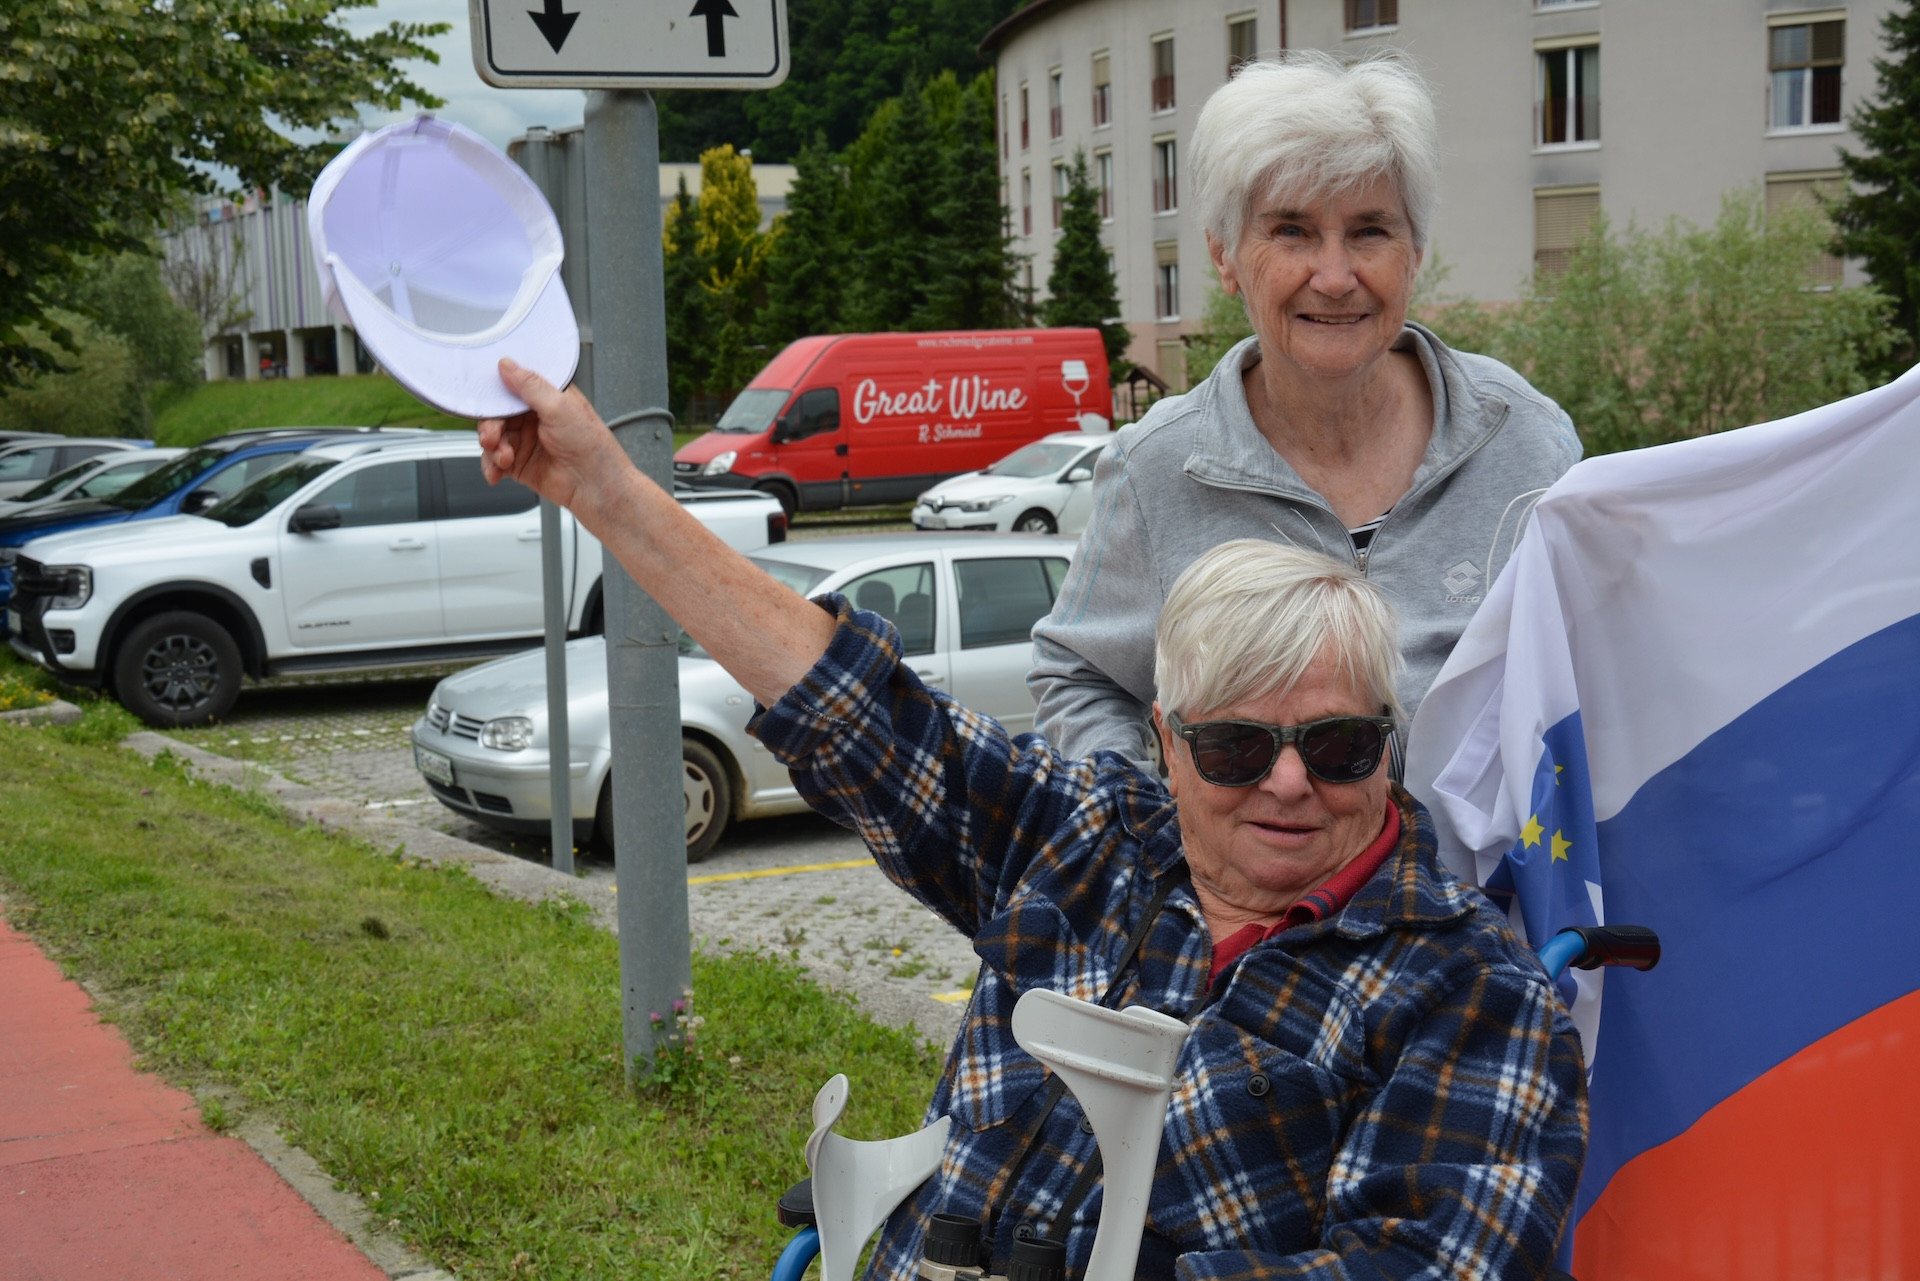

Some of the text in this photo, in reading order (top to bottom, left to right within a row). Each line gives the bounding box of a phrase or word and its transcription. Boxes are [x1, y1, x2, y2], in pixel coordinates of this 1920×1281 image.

[853, 374, 1028, 424] Great Wine
[1445, 593, 1481, 603] lotto
